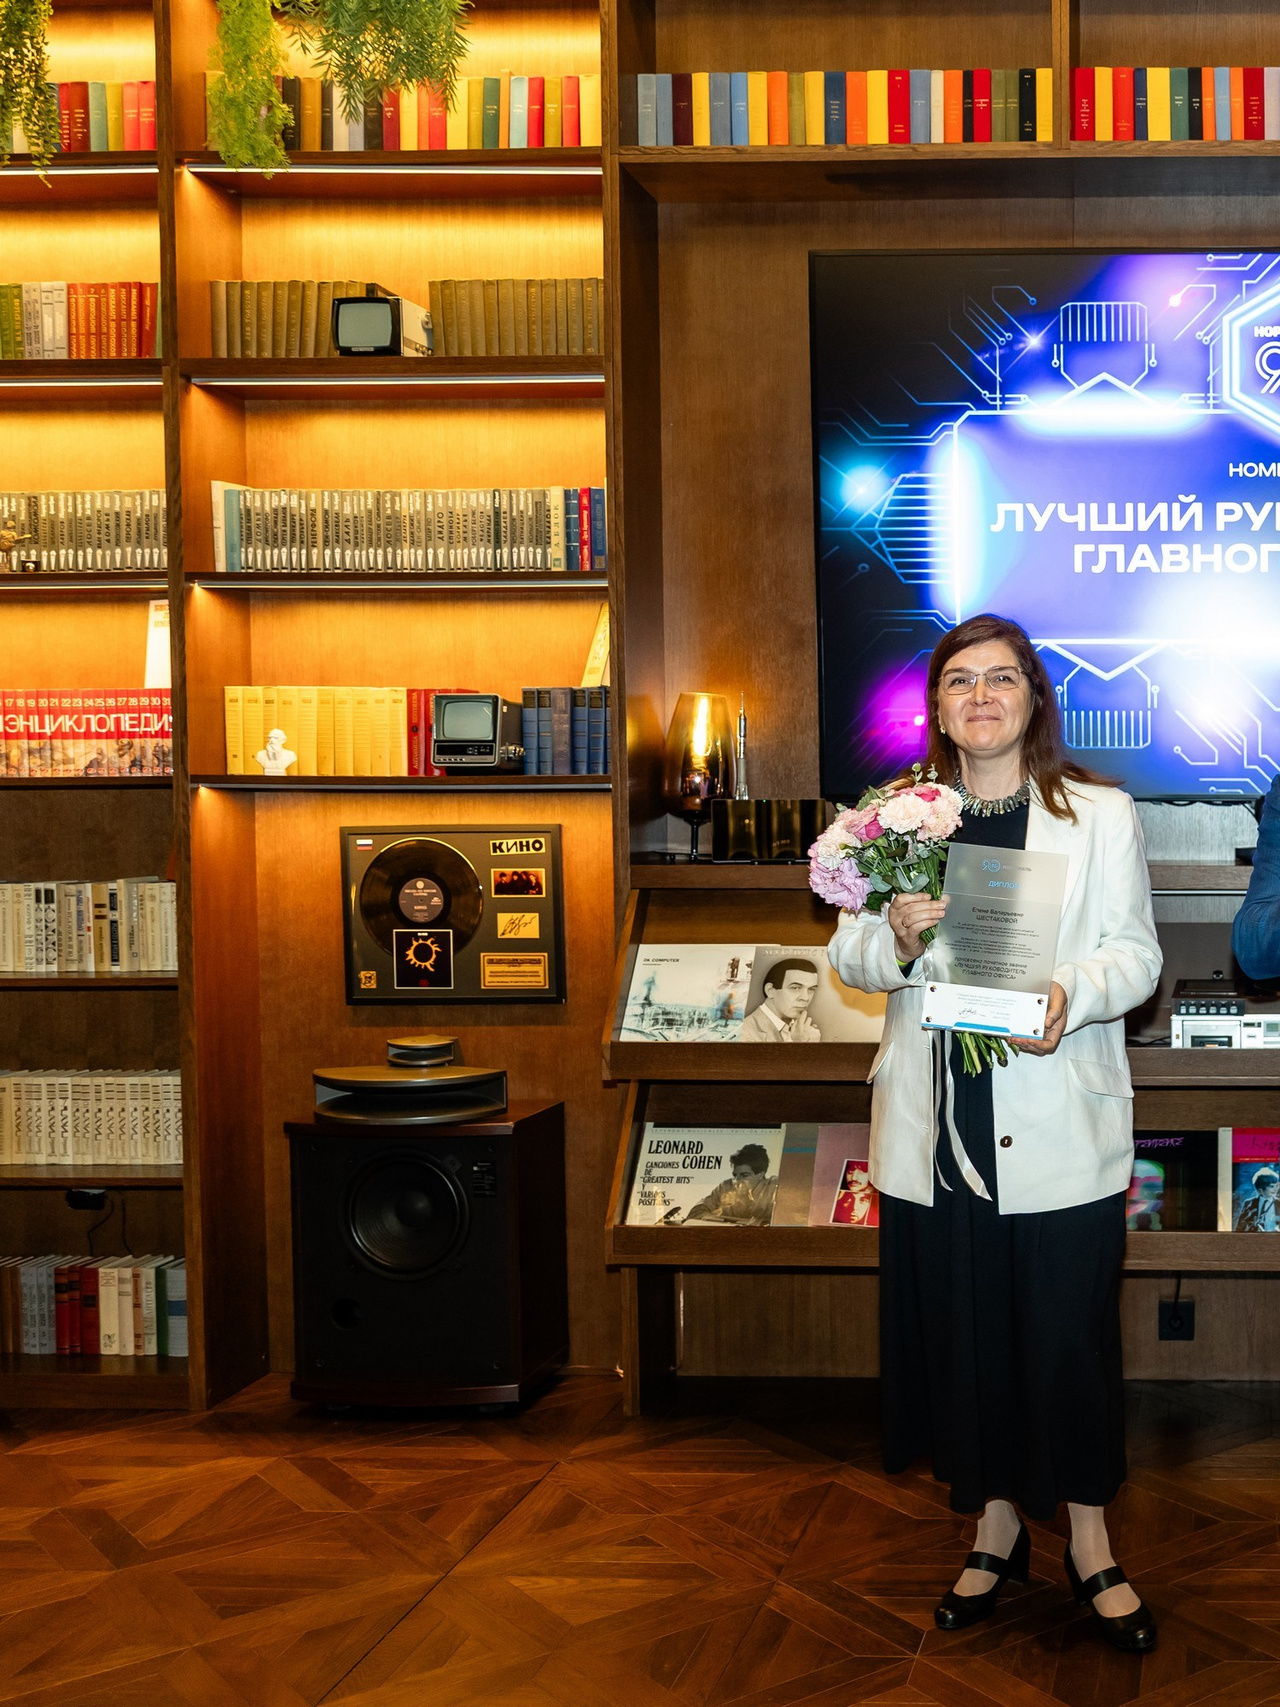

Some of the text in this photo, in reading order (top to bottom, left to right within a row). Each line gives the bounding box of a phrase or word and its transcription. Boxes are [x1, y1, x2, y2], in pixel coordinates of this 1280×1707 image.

[990, 494, 1207, 535] ЛУЧШИЙ
[27, 699, 35, 707] 19
[38, 698, 48, 706] 20
[50, 698, 58, 706] 21
[61, 698, 71, 706] 22
[72, 698, 82, 706] 23
[84, 698, 93, 706] 24
[95, 698, 104, 707] 25
[106, 698, 115, 706] 26
[118, 697, 126, 705] 27
[128, 697, 138, 706] 28
[140, 697, 149, 705] 29
[150, 697, 160, 706] 30
[492, 839, 544, 854] КИНО
[988, 881, 1021, 889] ДИПЛОМ
[976, 915, 1018, 923] ШЕСТАКОВОЙ
[982, 965, 1026, 975] РУКОВОДИТЕЛЬ
[648, 1140, 703, 1154] LEONARD
[682, 1156, 722, 1169] COHEN
[676, 1176, 694, 1184] HITS"
